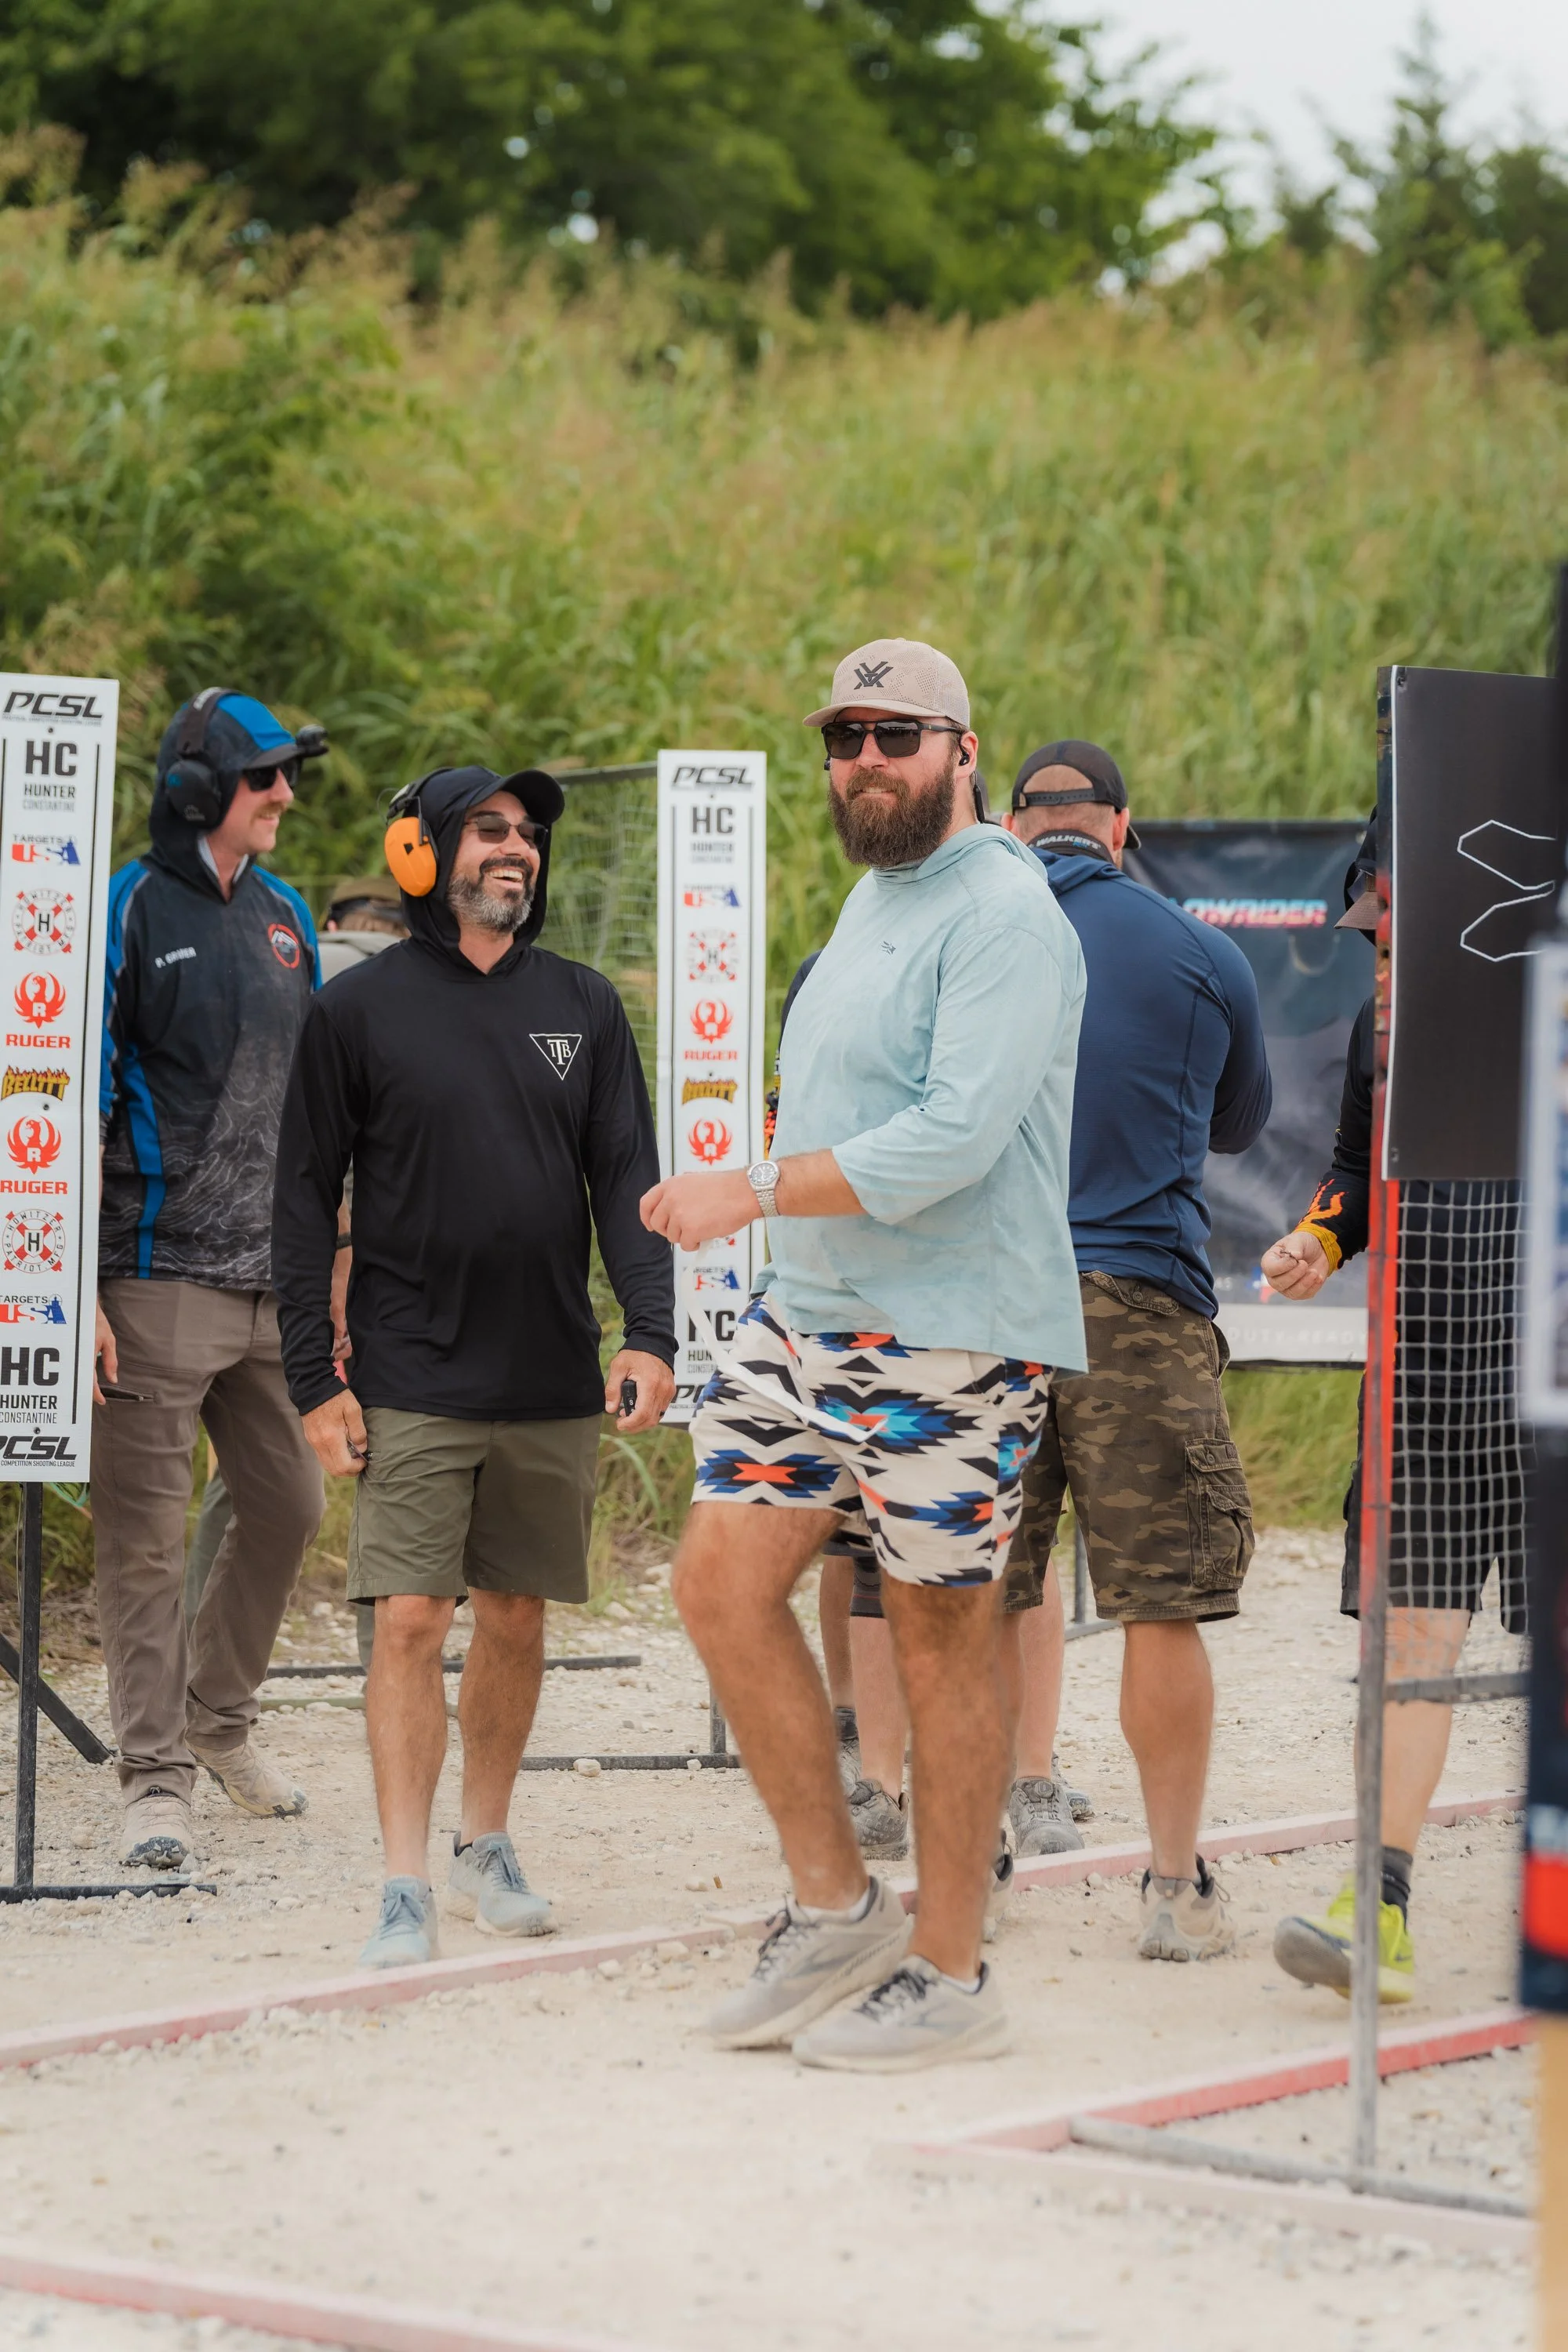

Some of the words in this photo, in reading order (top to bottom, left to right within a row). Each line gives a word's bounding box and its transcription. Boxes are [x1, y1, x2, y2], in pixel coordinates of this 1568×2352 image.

[3, 691, 103, 719] PCSL
[25, 740, 78, 776] HC
[673, 767, 753, 786] PCSL
[24, 783, 75, 798] HUNTER
[691, 807, 734, 834] HC
[13, 834, 63, 844] TARGETS
[1168, 898, 1328, 928] OWRIDER
[39, 913, 49, 932] H
[33, 1002, 47, 1017] R
[6, 1034, 71, 1049] RUGER
[684, 1051, 738, 1061] RUGER
[27, 1147, 42, 1162] R
[0, 1181, 68, 1195] RUGER
[28, 1232, 40, 1252] H
[0, 1347, 60, 1386] HC
[0, 1395, 57, 1410] HUNTER
[0, 1412, 57, 1424] CONSTANTINE
